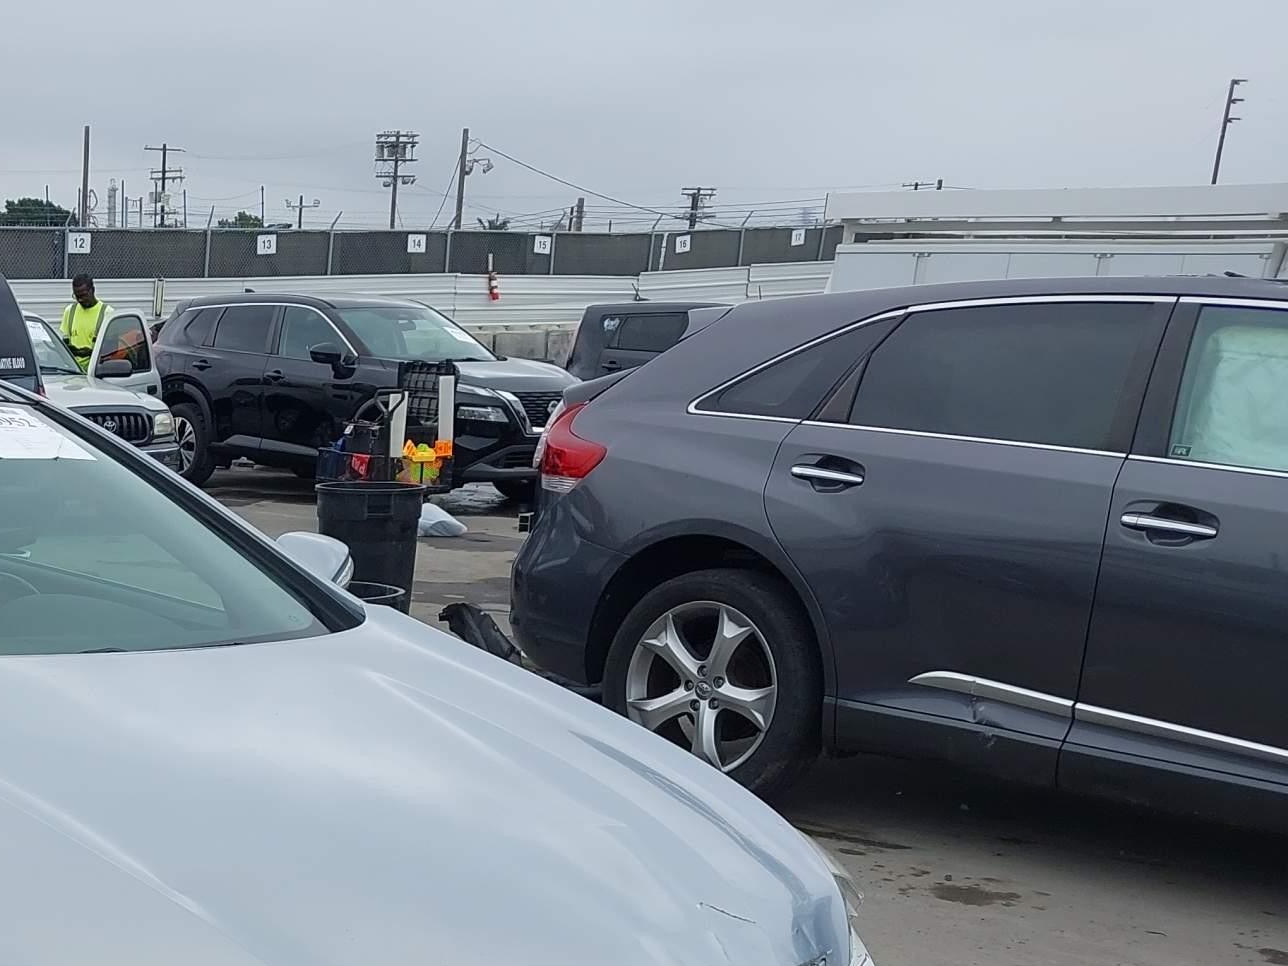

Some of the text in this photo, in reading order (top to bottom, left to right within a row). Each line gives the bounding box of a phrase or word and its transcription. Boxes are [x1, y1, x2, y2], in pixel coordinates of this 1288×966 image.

[73, 237, 85, 249] 12
[262, 239, 272, 250] 13
[412, 239, 422, 249] 14
[539, 240, 547, 250] 15
[679, 240, 687, 249] 16
